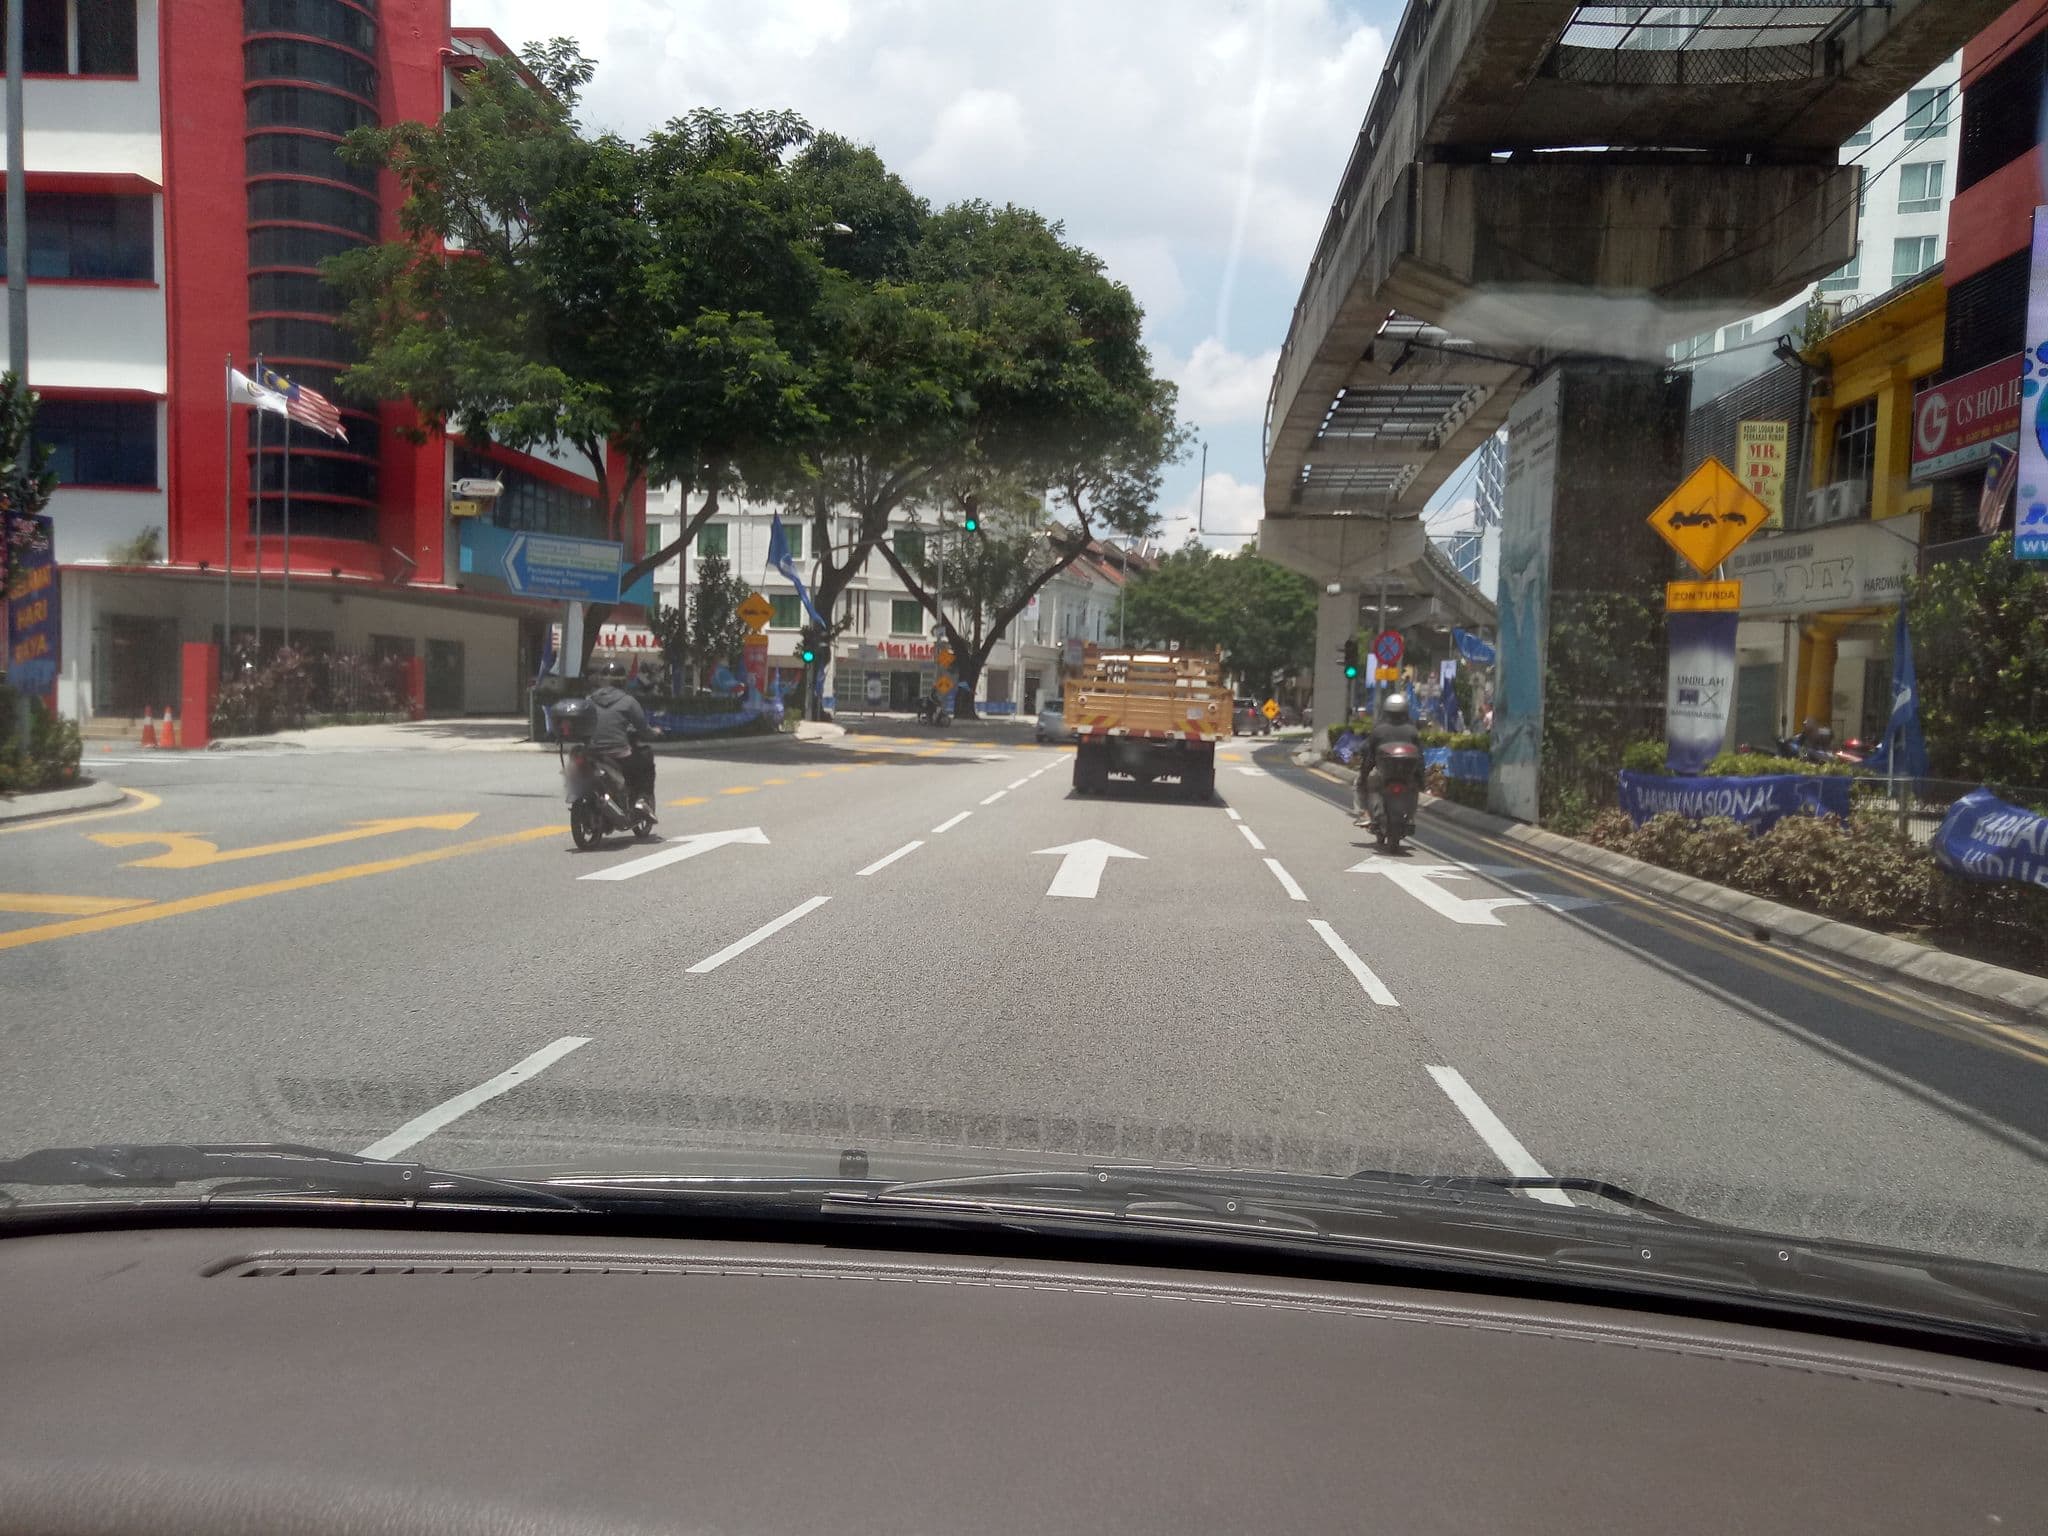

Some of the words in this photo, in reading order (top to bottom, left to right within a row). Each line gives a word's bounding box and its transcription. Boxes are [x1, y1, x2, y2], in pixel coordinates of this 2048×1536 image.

[1956, 396, 1974, 426] CS
[1697, 590, 1737, 601] TUNDA
[1683, 784, 1780, 816] NASIONAL
